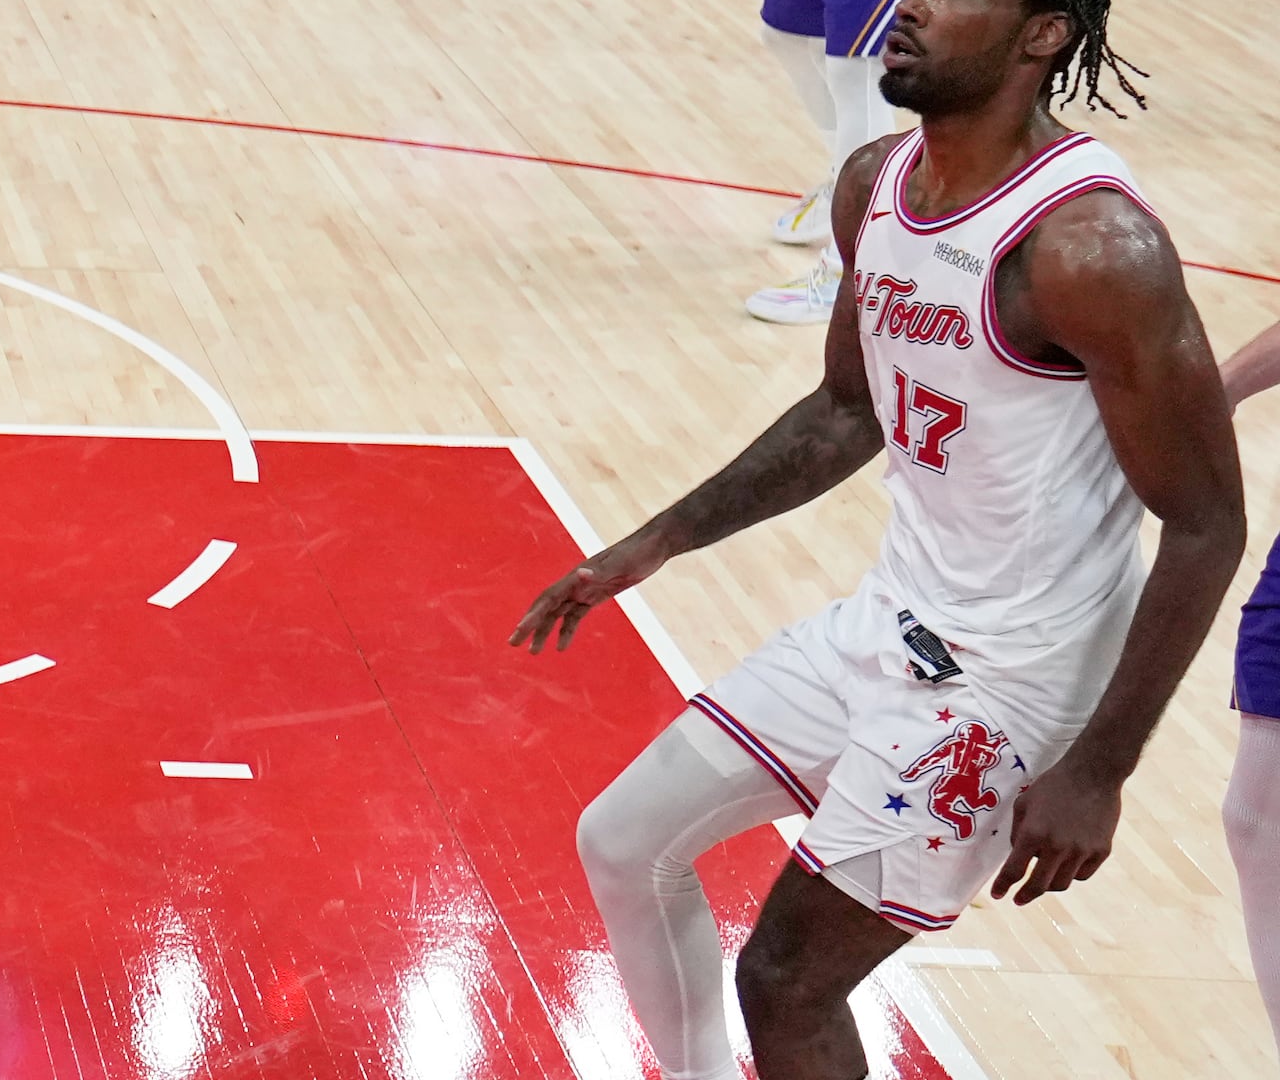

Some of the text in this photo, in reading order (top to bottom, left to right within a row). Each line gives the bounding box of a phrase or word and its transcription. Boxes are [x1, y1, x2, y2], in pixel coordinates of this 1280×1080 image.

[933, 248, 982, 277] HERMANN
[936, 240, 985, 271] MEMORIAL
[890, 364, 967, 475] 17
